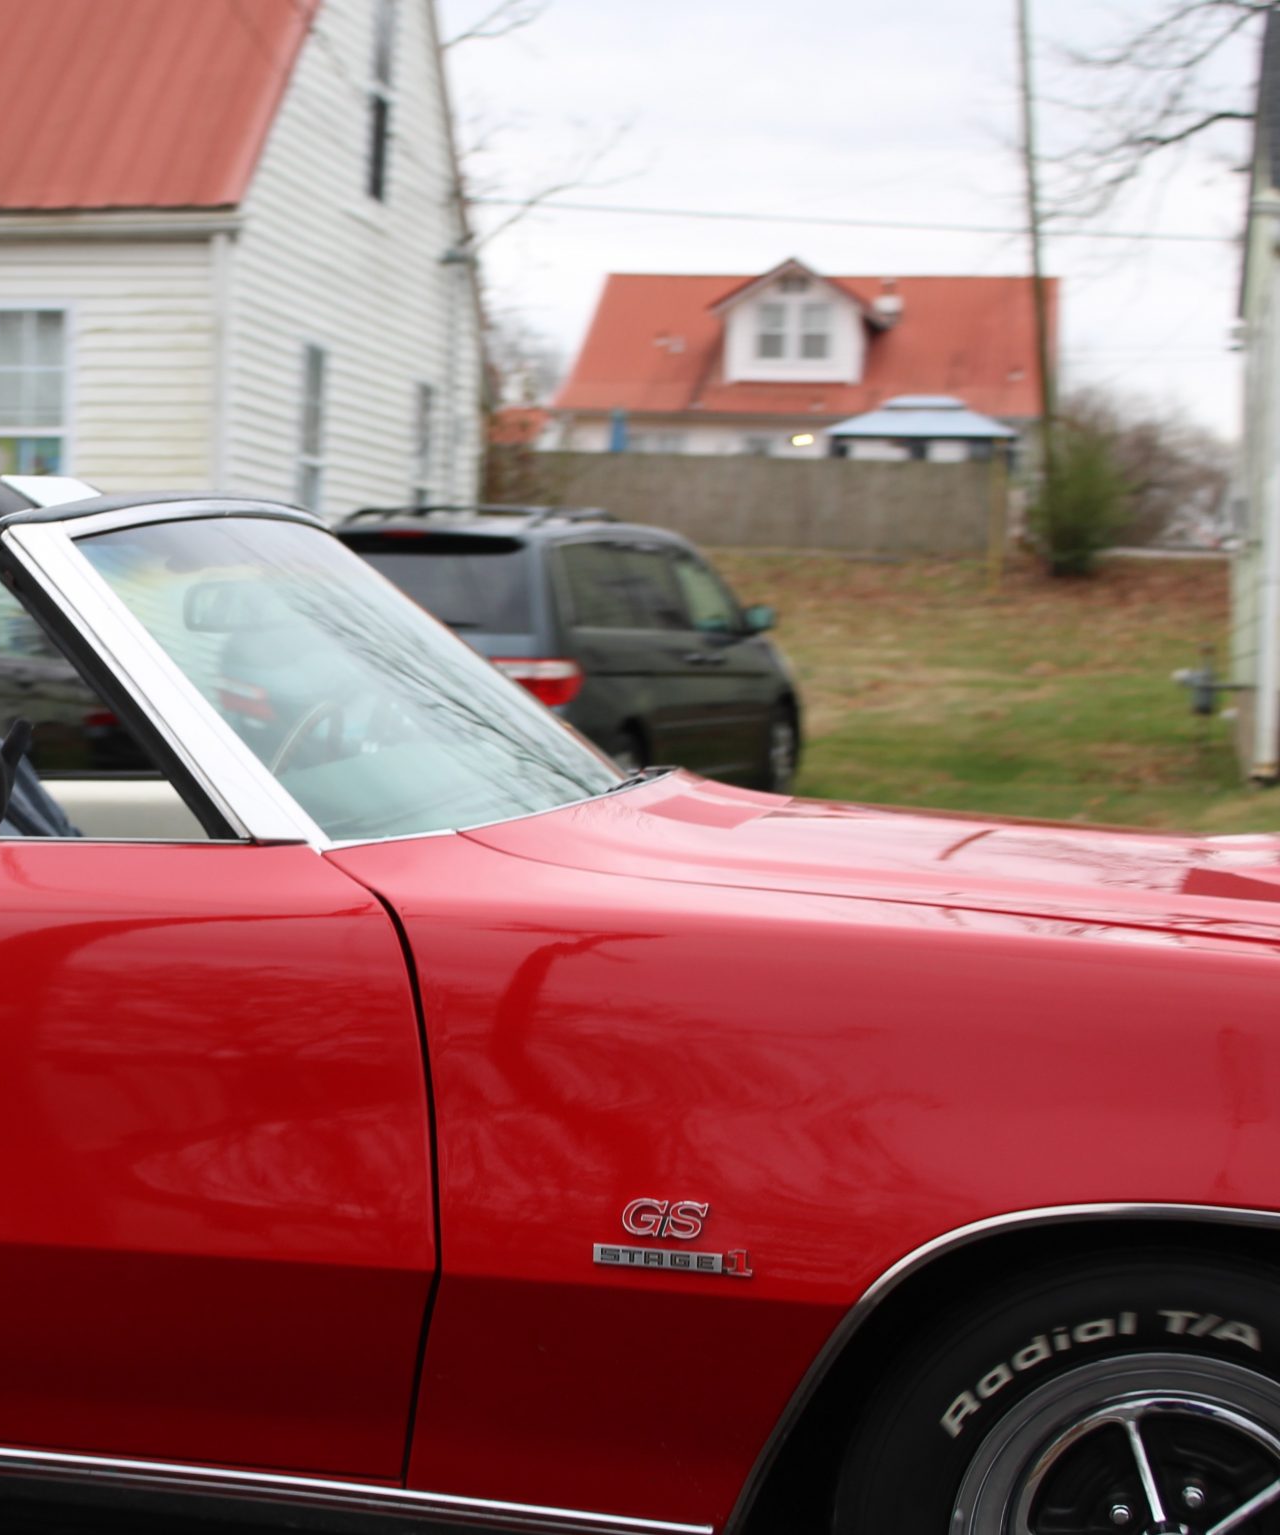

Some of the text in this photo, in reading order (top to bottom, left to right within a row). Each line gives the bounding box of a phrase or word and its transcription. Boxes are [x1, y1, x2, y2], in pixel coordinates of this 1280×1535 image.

[622, 1197, 710, 1239] GS
[599, 1246, 753, 1277] STAGE 1
[939, 1309, 1262, 1439] Radial T/A
